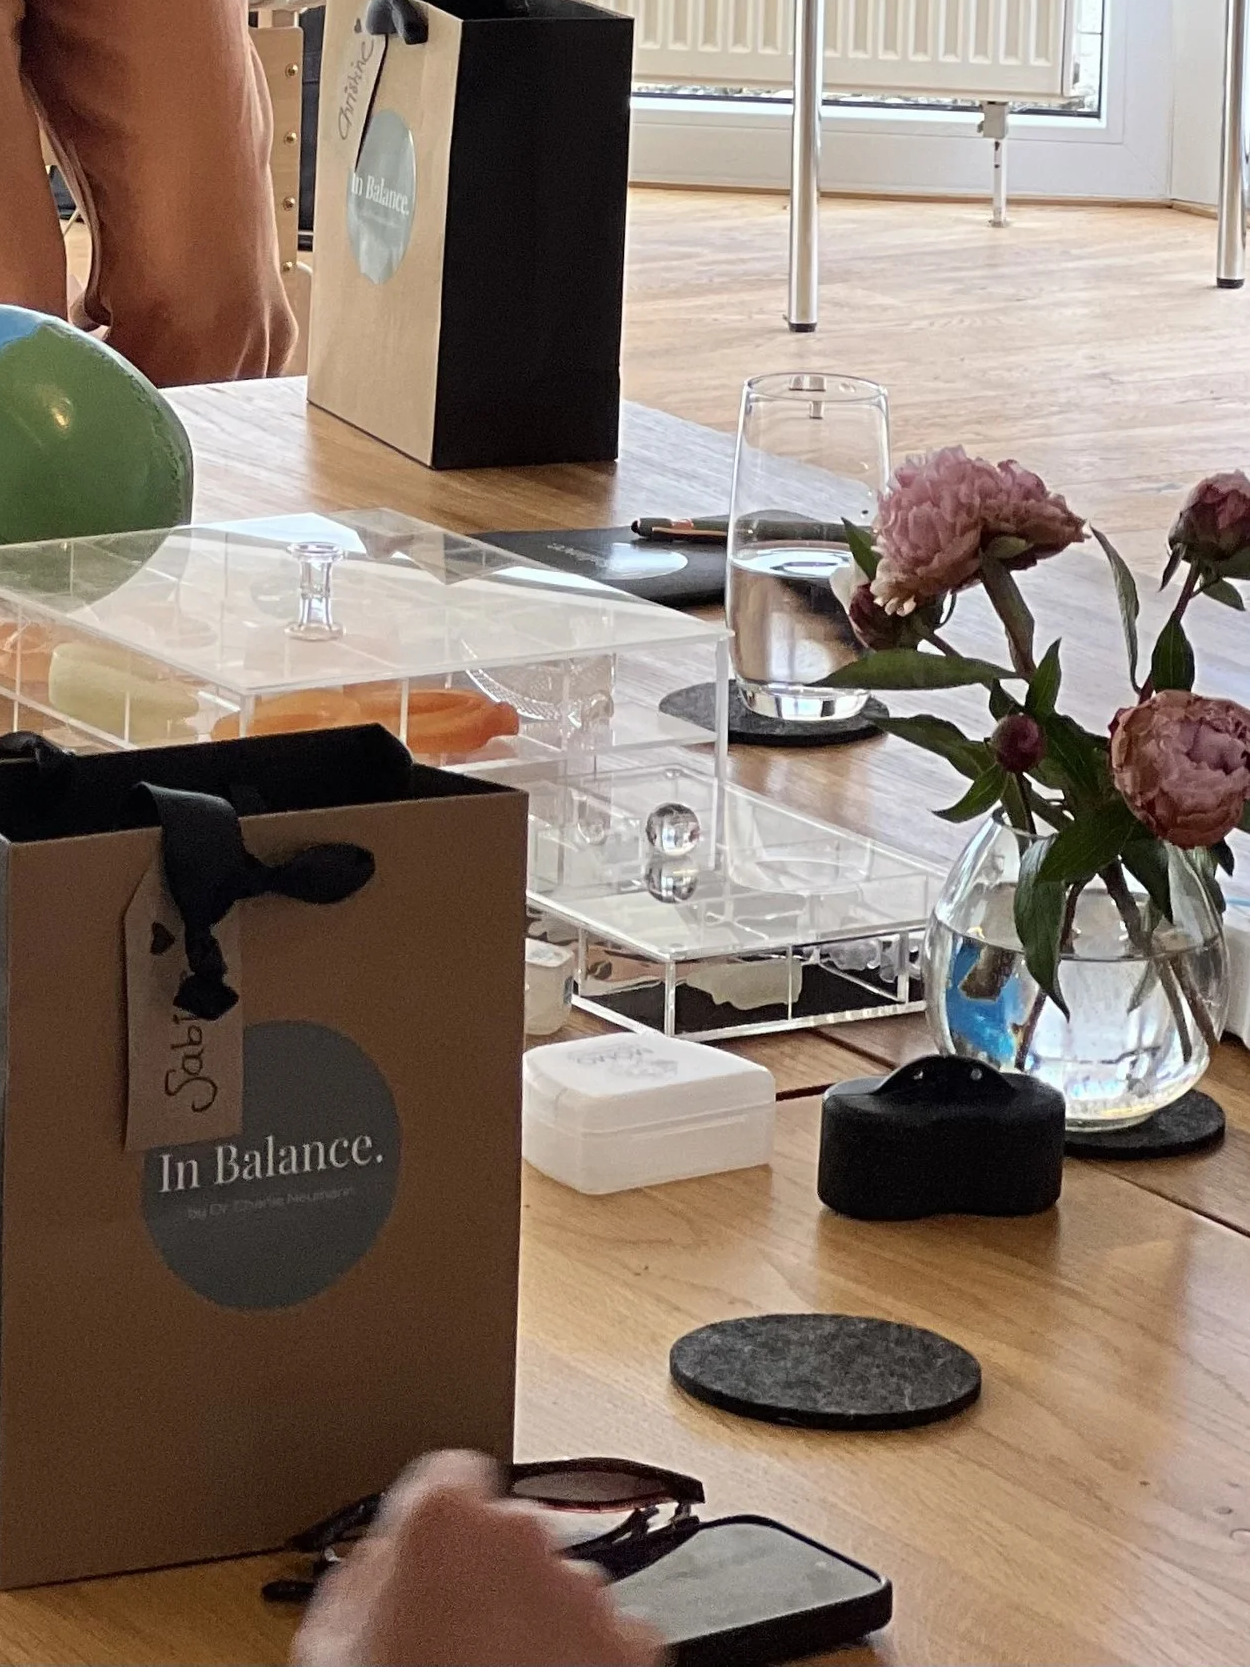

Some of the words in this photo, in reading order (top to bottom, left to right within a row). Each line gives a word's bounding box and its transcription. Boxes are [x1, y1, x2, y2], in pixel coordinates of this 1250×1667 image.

[338, 40, 374, 140] Christine
[352, 173, 363, 196] In
[366, 174, 410, 215] Balance.
[159, 1153, 200, 1193] In
[213, 1135, 384, 1185] Balance.
